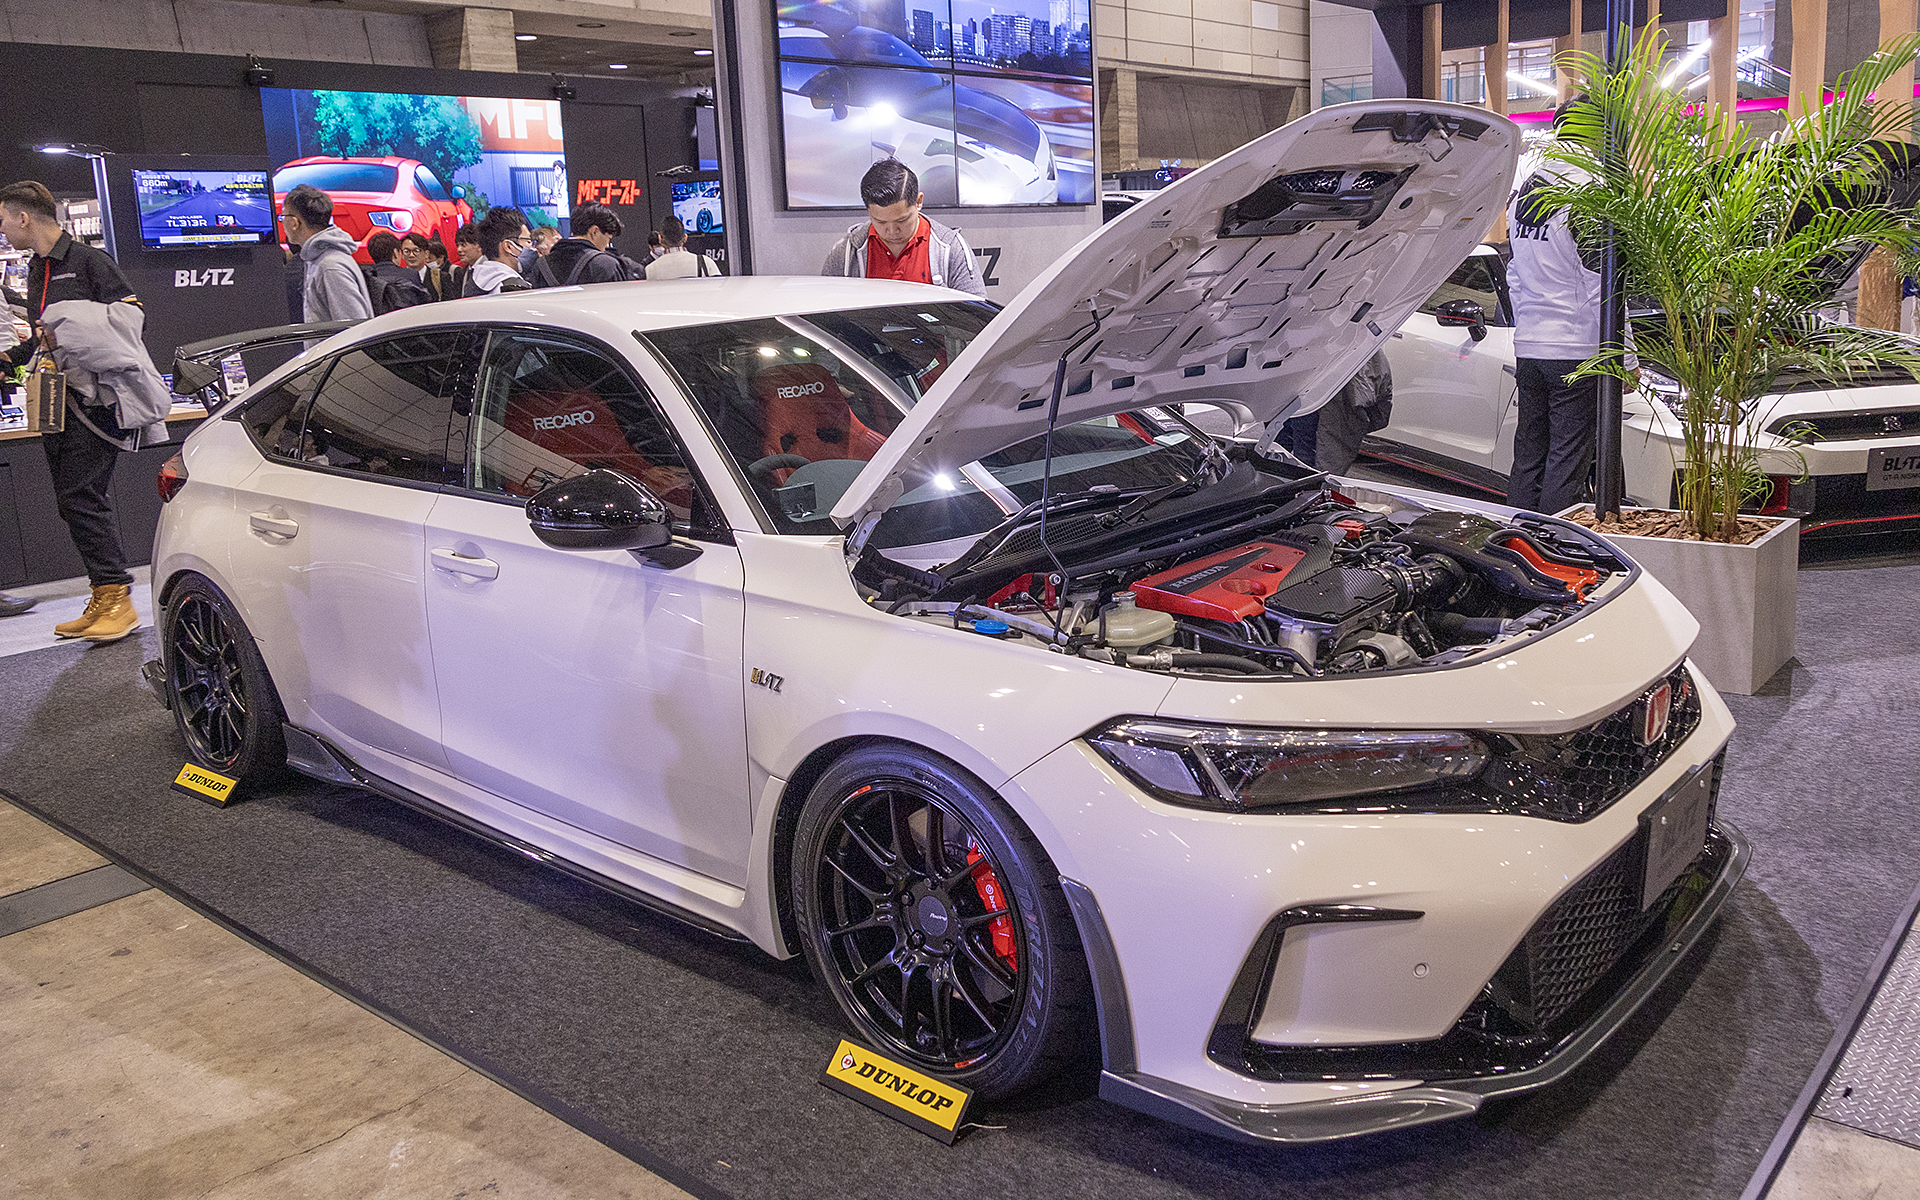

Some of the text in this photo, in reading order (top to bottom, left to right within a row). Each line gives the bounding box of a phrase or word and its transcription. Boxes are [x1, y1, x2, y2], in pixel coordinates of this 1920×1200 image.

[142, 179, 168, 187] 660m
[237, 174, 262, 183] BLITZ
[576, 179, 642, 206] MFゴースト
[165, 219, 208, 227] TL313R
[705, 248, 726, 261] BLIT
[174, 267, 235, 288] BLITZ
[777, 381, 825, 399] RECARO
[532, 409, 595, 431] RECARO
[1169, 565, 1230, 588] HONDA
[750, 667, 785, 693] BLITZ
[188, 773, 229, 793] DUNLOP
[855, 1061, 954, 1112] DUNLOP
